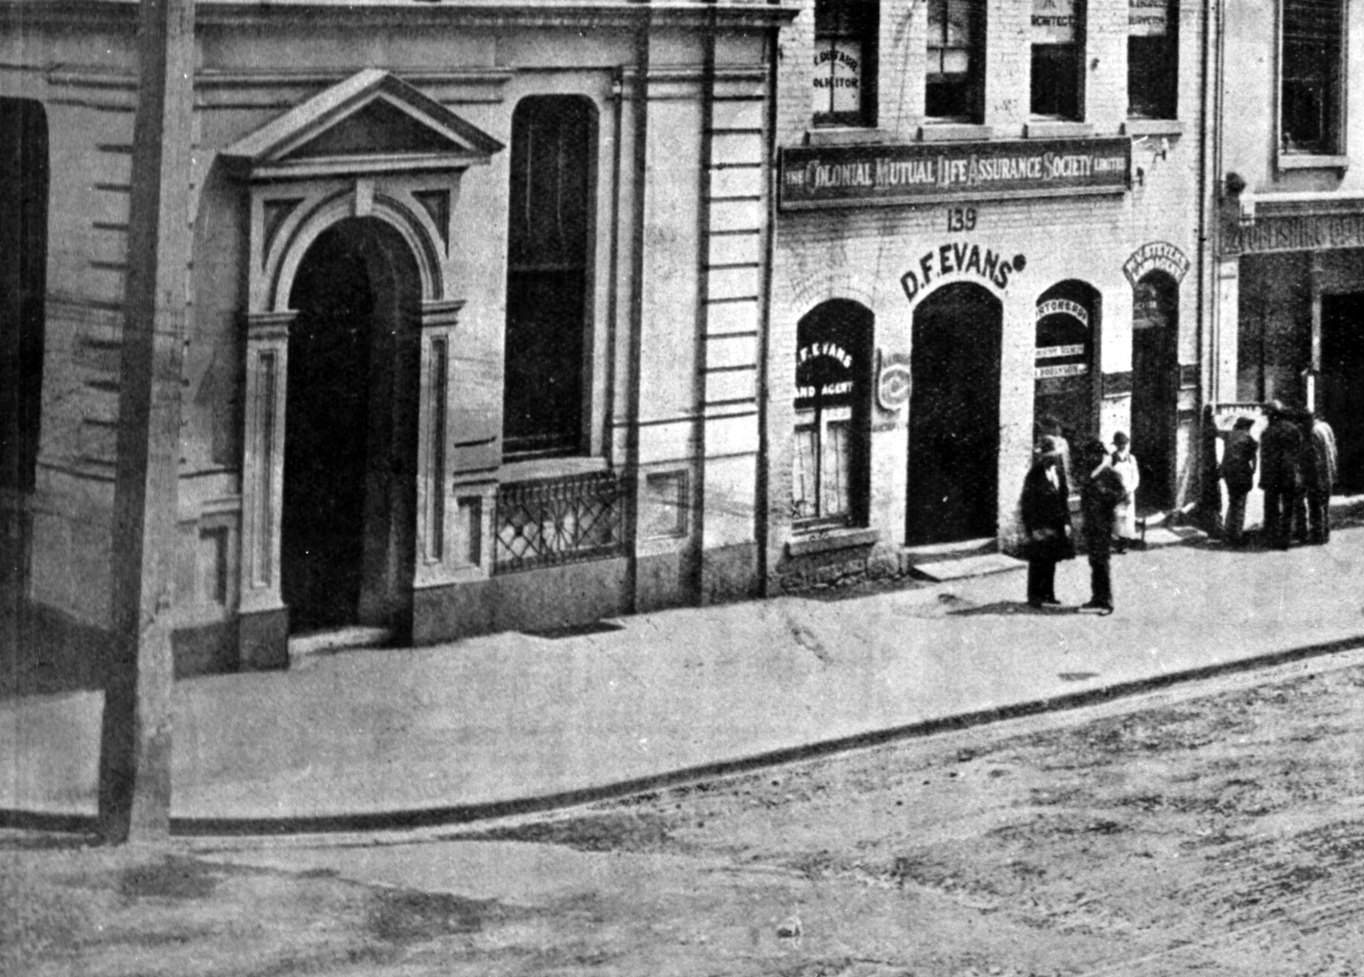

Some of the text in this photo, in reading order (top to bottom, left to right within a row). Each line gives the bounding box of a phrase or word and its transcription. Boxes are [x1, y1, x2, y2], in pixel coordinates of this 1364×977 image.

[785, 170, 804, 184] THE
[805, 159, 873, 193] COLONIAL
[873, 157, 935, 190] MUTUAL
[936, 155, 967, 188] LIFE
[966, 154, 1042, 185] ASSURANCE
[1041, 152, 1093, 181] SOCIETY
[947, 207, 977, 233] 139
[821, 381, 854, 395] AGENT
